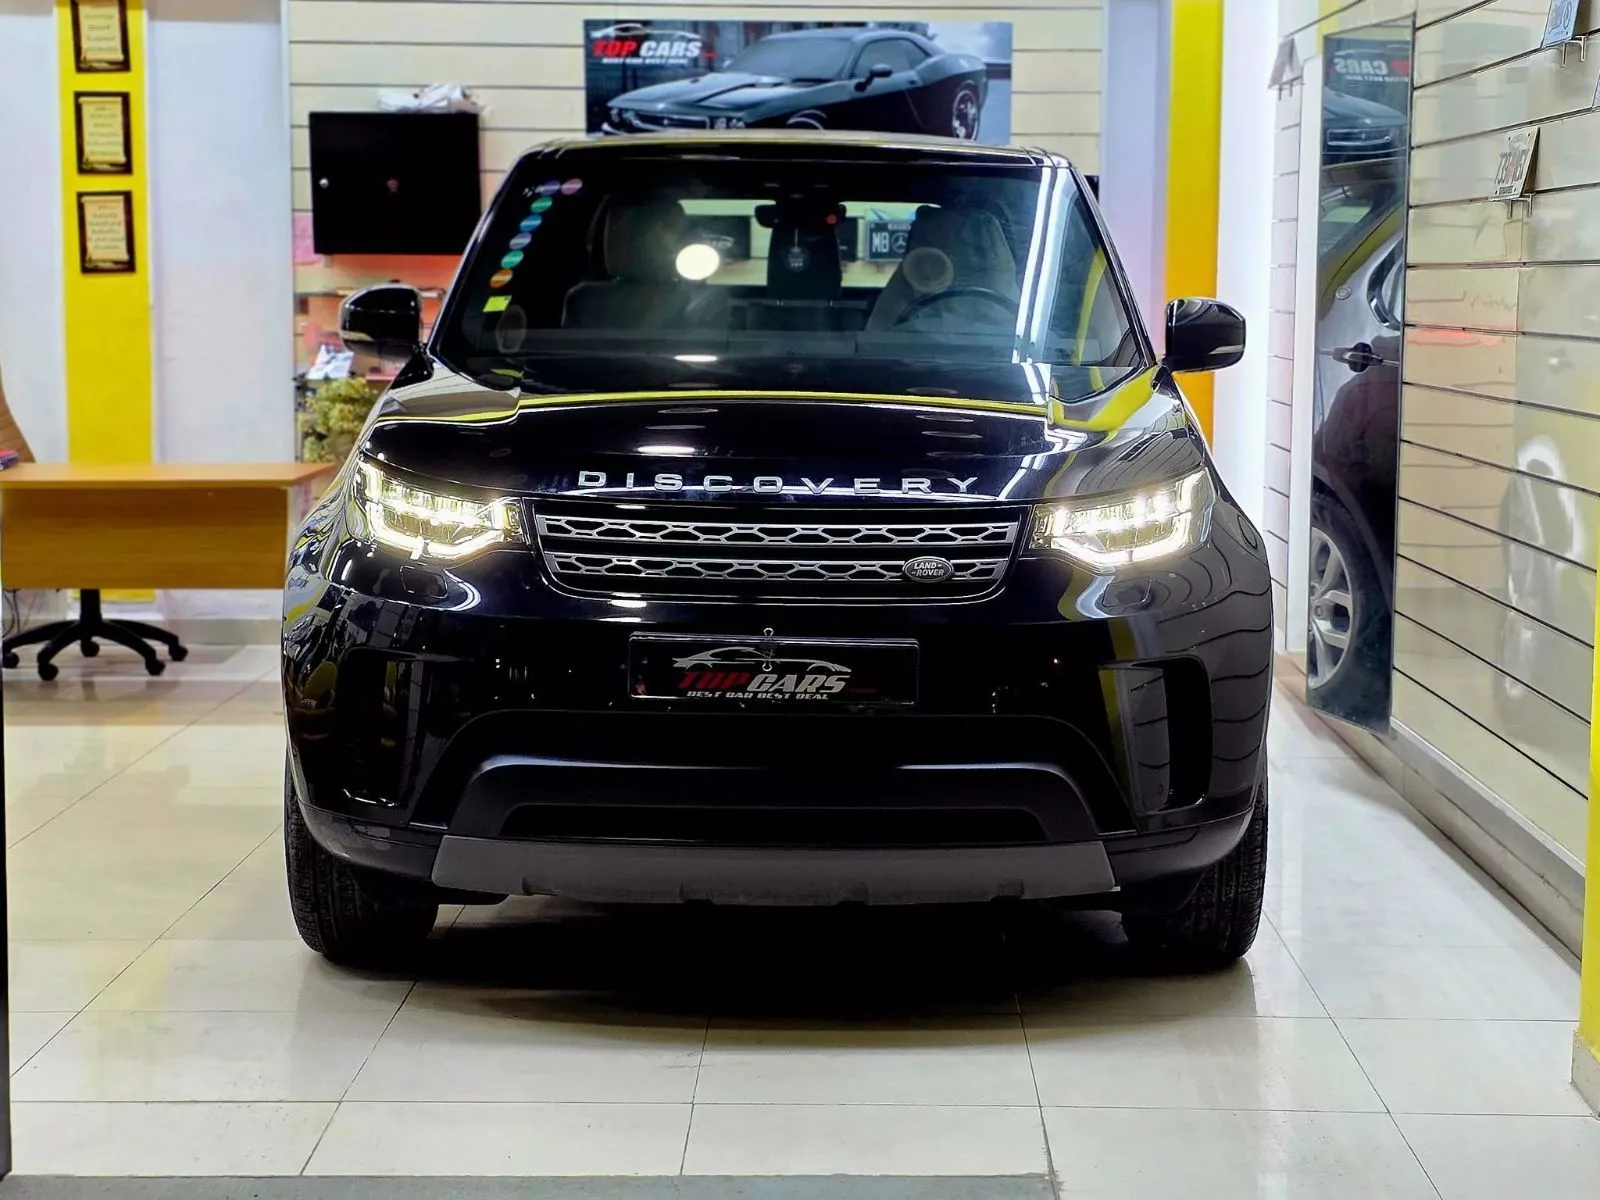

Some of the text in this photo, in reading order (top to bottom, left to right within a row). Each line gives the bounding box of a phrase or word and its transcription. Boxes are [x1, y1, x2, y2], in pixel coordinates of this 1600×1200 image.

[593, 40, 702, 58] TOP CARS
[578, 470, 979, 494] DISCOVERY
[679, 671, 850, 693] TOP CARS
[686, 691, 721, 699] BEST
